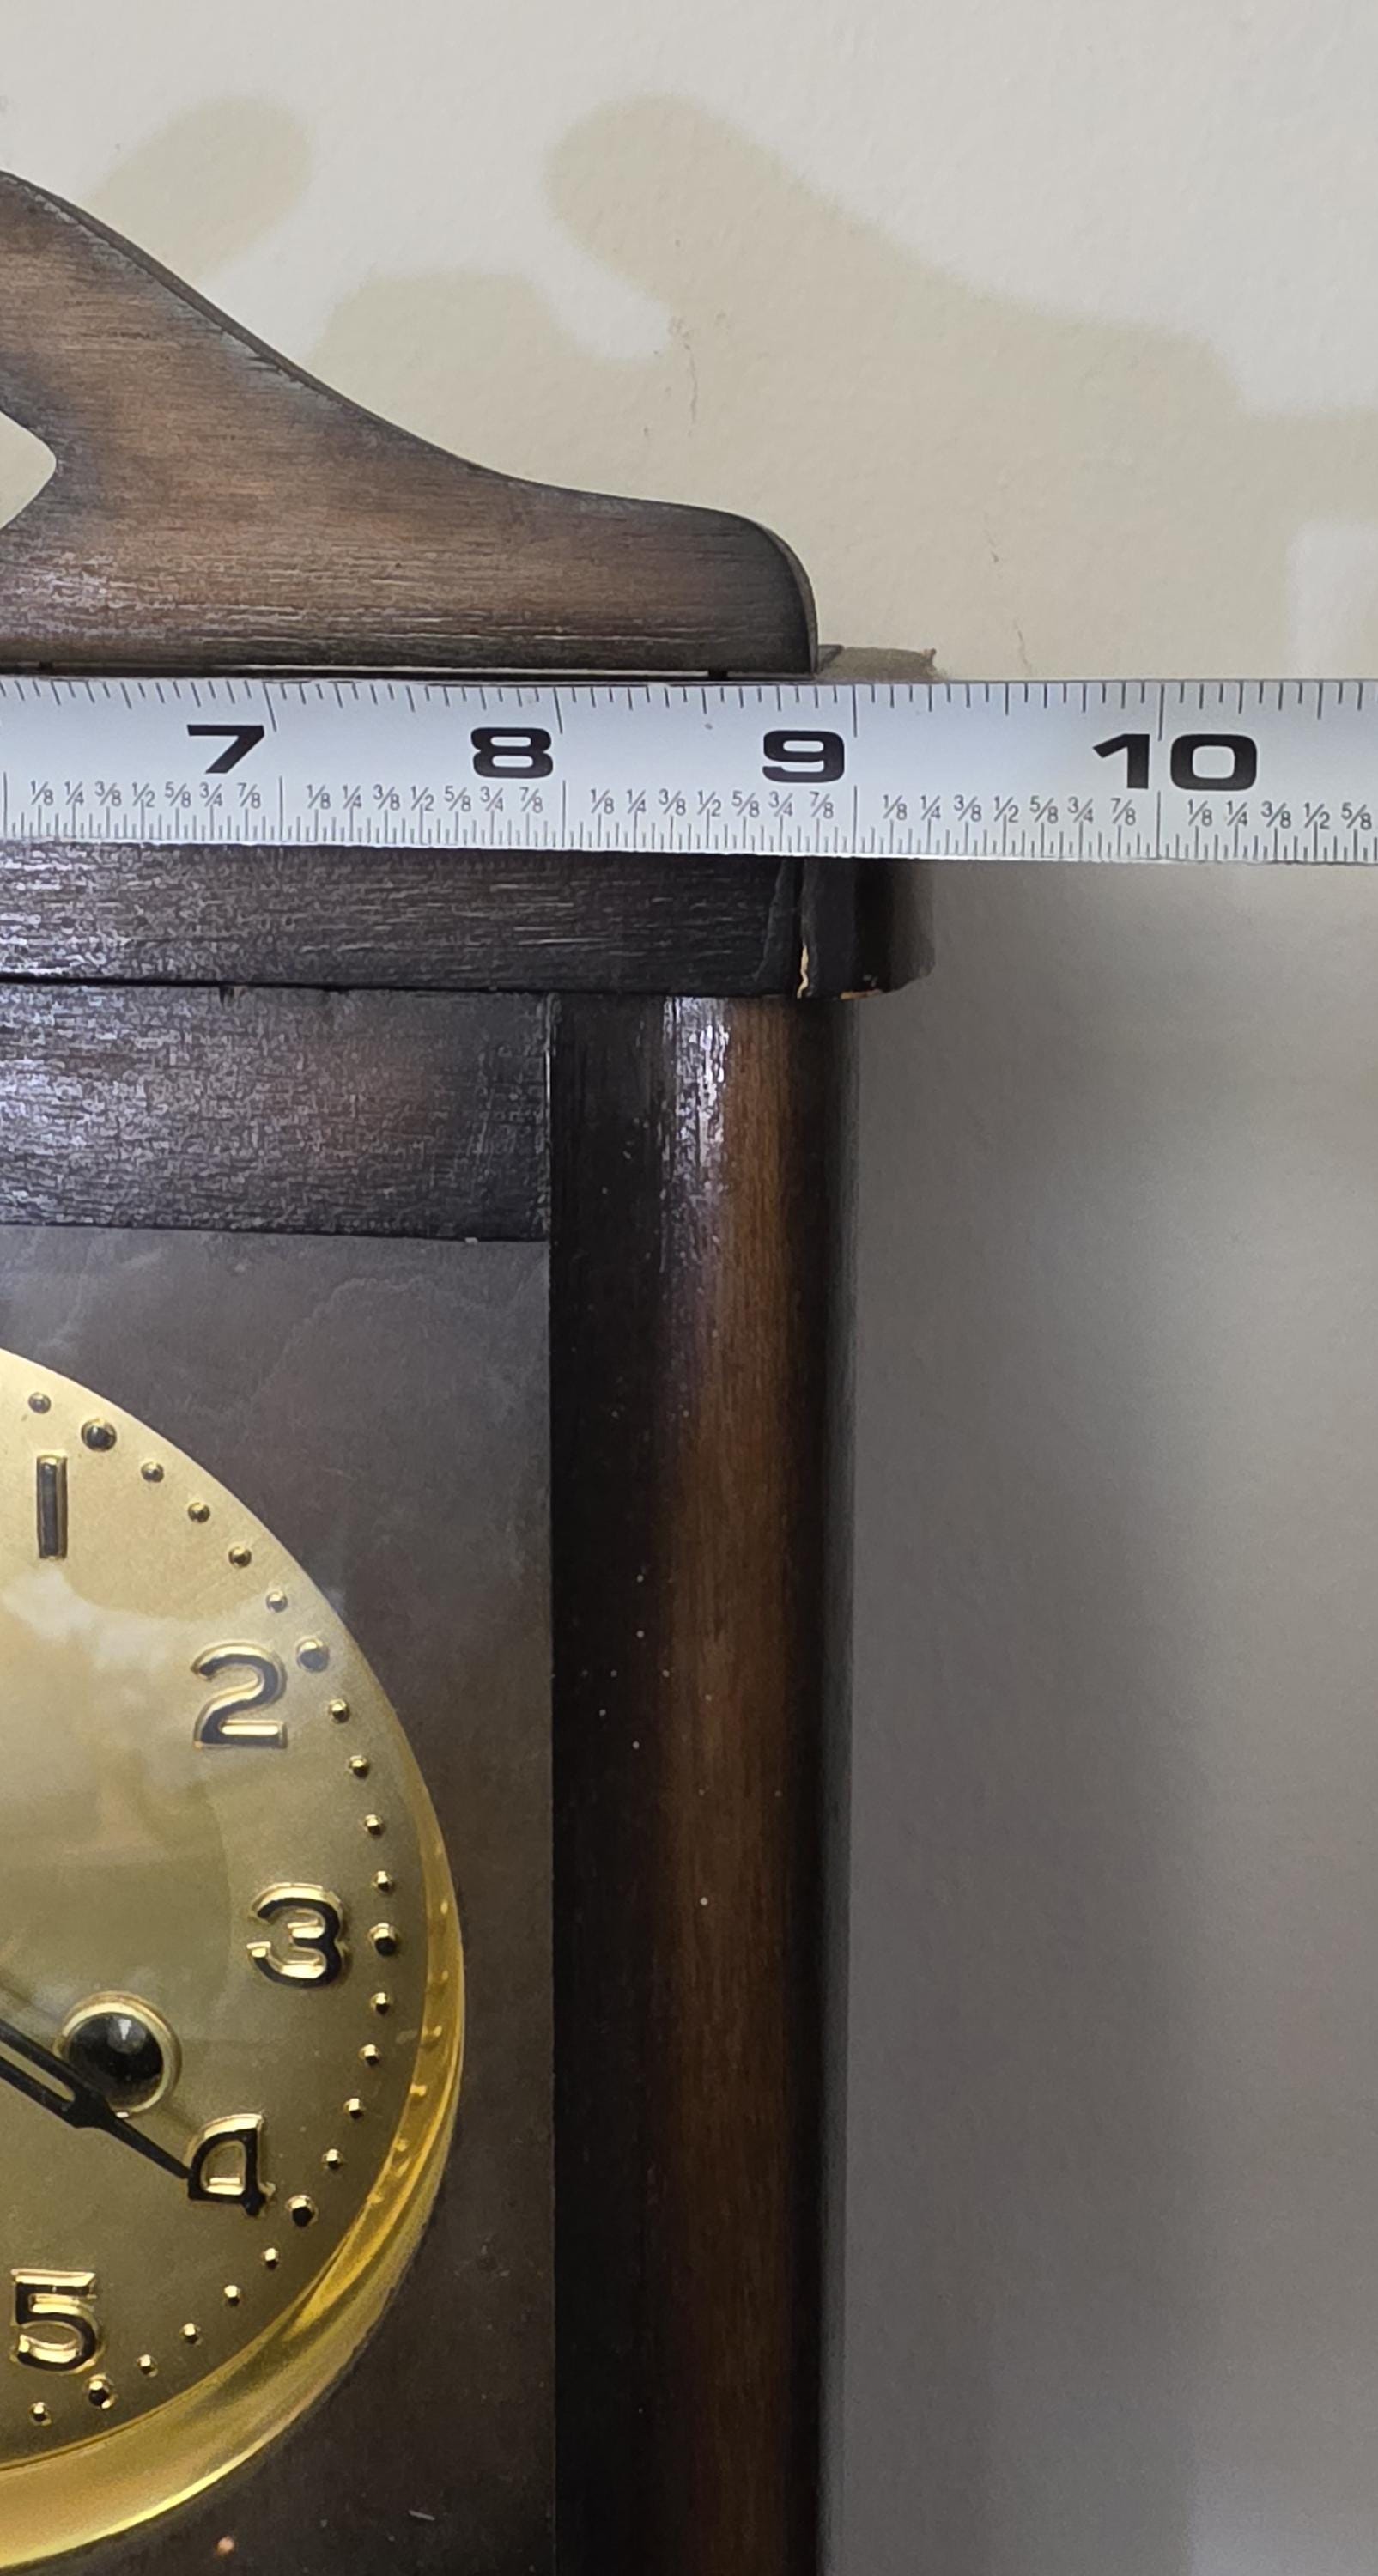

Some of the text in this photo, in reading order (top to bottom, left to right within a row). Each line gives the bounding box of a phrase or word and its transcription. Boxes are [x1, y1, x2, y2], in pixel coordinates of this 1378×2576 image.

[186, 725, 1258, 791] 7 8 9 10
[190, 1639, 288, 1749] 2
[247, 1882, 347, 1988] 3
[187, 2113, 276, 2217] 4
[10, 2268, 104, 2372] 5
